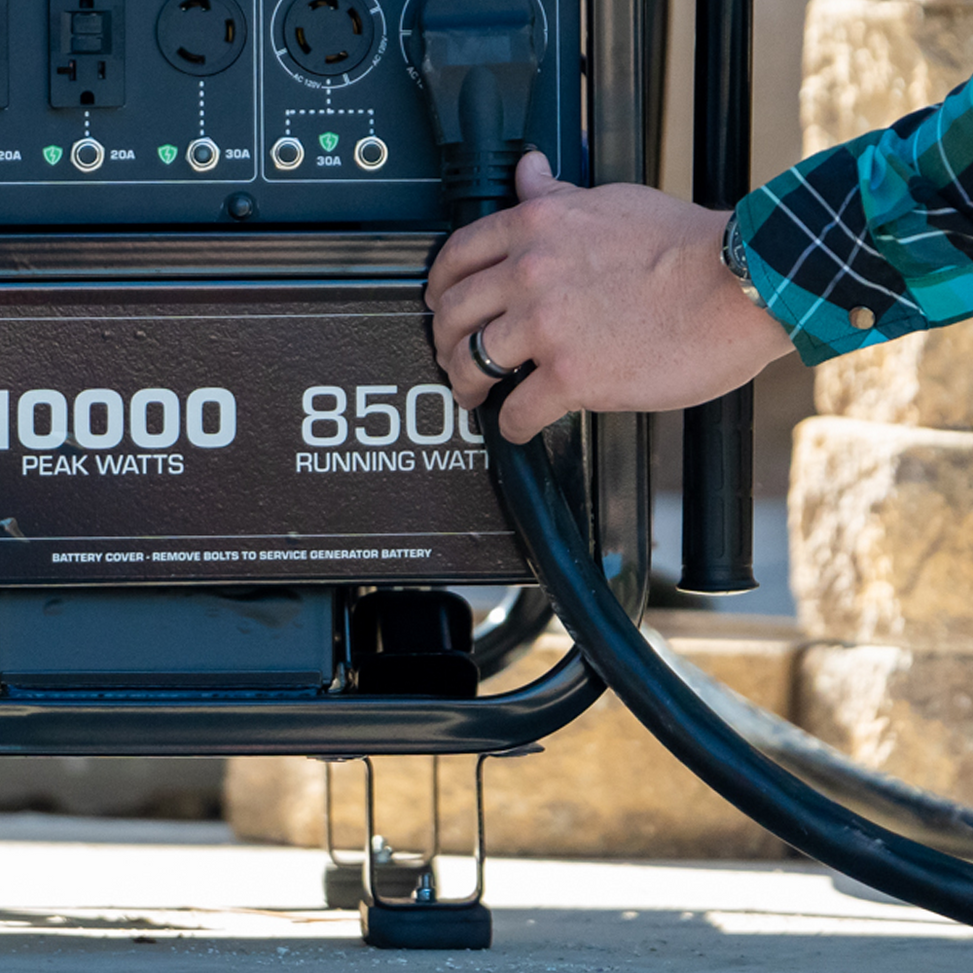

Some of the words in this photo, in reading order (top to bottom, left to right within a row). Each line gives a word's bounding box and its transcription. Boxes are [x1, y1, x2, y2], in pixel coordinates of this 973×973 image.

[292, 72, 304, 83] AC
[111, 150, 135, 159] 20A
[226, 149, 250, 159] 30A
[317, 156, 341, 166] 30A
[23, 455, 88, 475] PEAK
[95, 454, 183, 475] WATTS
[296, 450, 416, 473] RUNNING
[422, 450, 489, 471] WATT
[53, 553, 102, 562] BATTERY
[105, 552, 143, 561] COVER
[153, 552, 200, 561] REMOVE
[204, 551, 239, 561] BOLTS
[259, 550, 307, 560] SERVICE
[310, 549, 378, 559] GENERATOR
[381, 549, 431, 559] BATTERY
